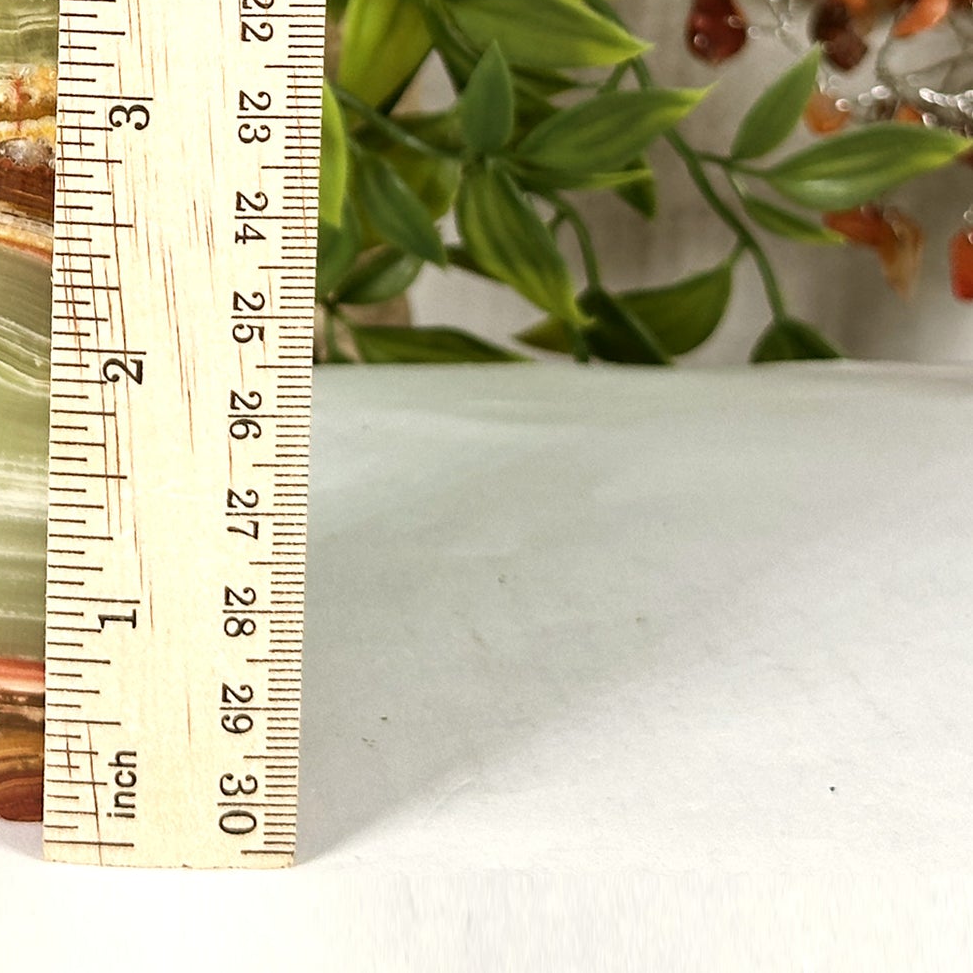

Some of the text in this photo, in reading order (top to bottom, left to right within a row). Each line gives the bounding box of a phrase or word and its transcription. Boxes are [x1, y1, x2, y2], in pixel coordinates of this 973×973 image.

[108, 104, 150, 131] 3
[237, 90, 272, 144] 23
[234, 191, 269, 245] 24
[232, 291, 266, 344] 25
[102, 357, 144, 385] 2
[229, 390, 262, 440] 26
[226, 488, 259, 540] 27
[97, 608, 137, 629] 1
[223, 586, 257, 638] 28
[221, 682, 254, 735] 29
[106, 750, 137, 818] inch
[218, 773, 258, 836] 30
